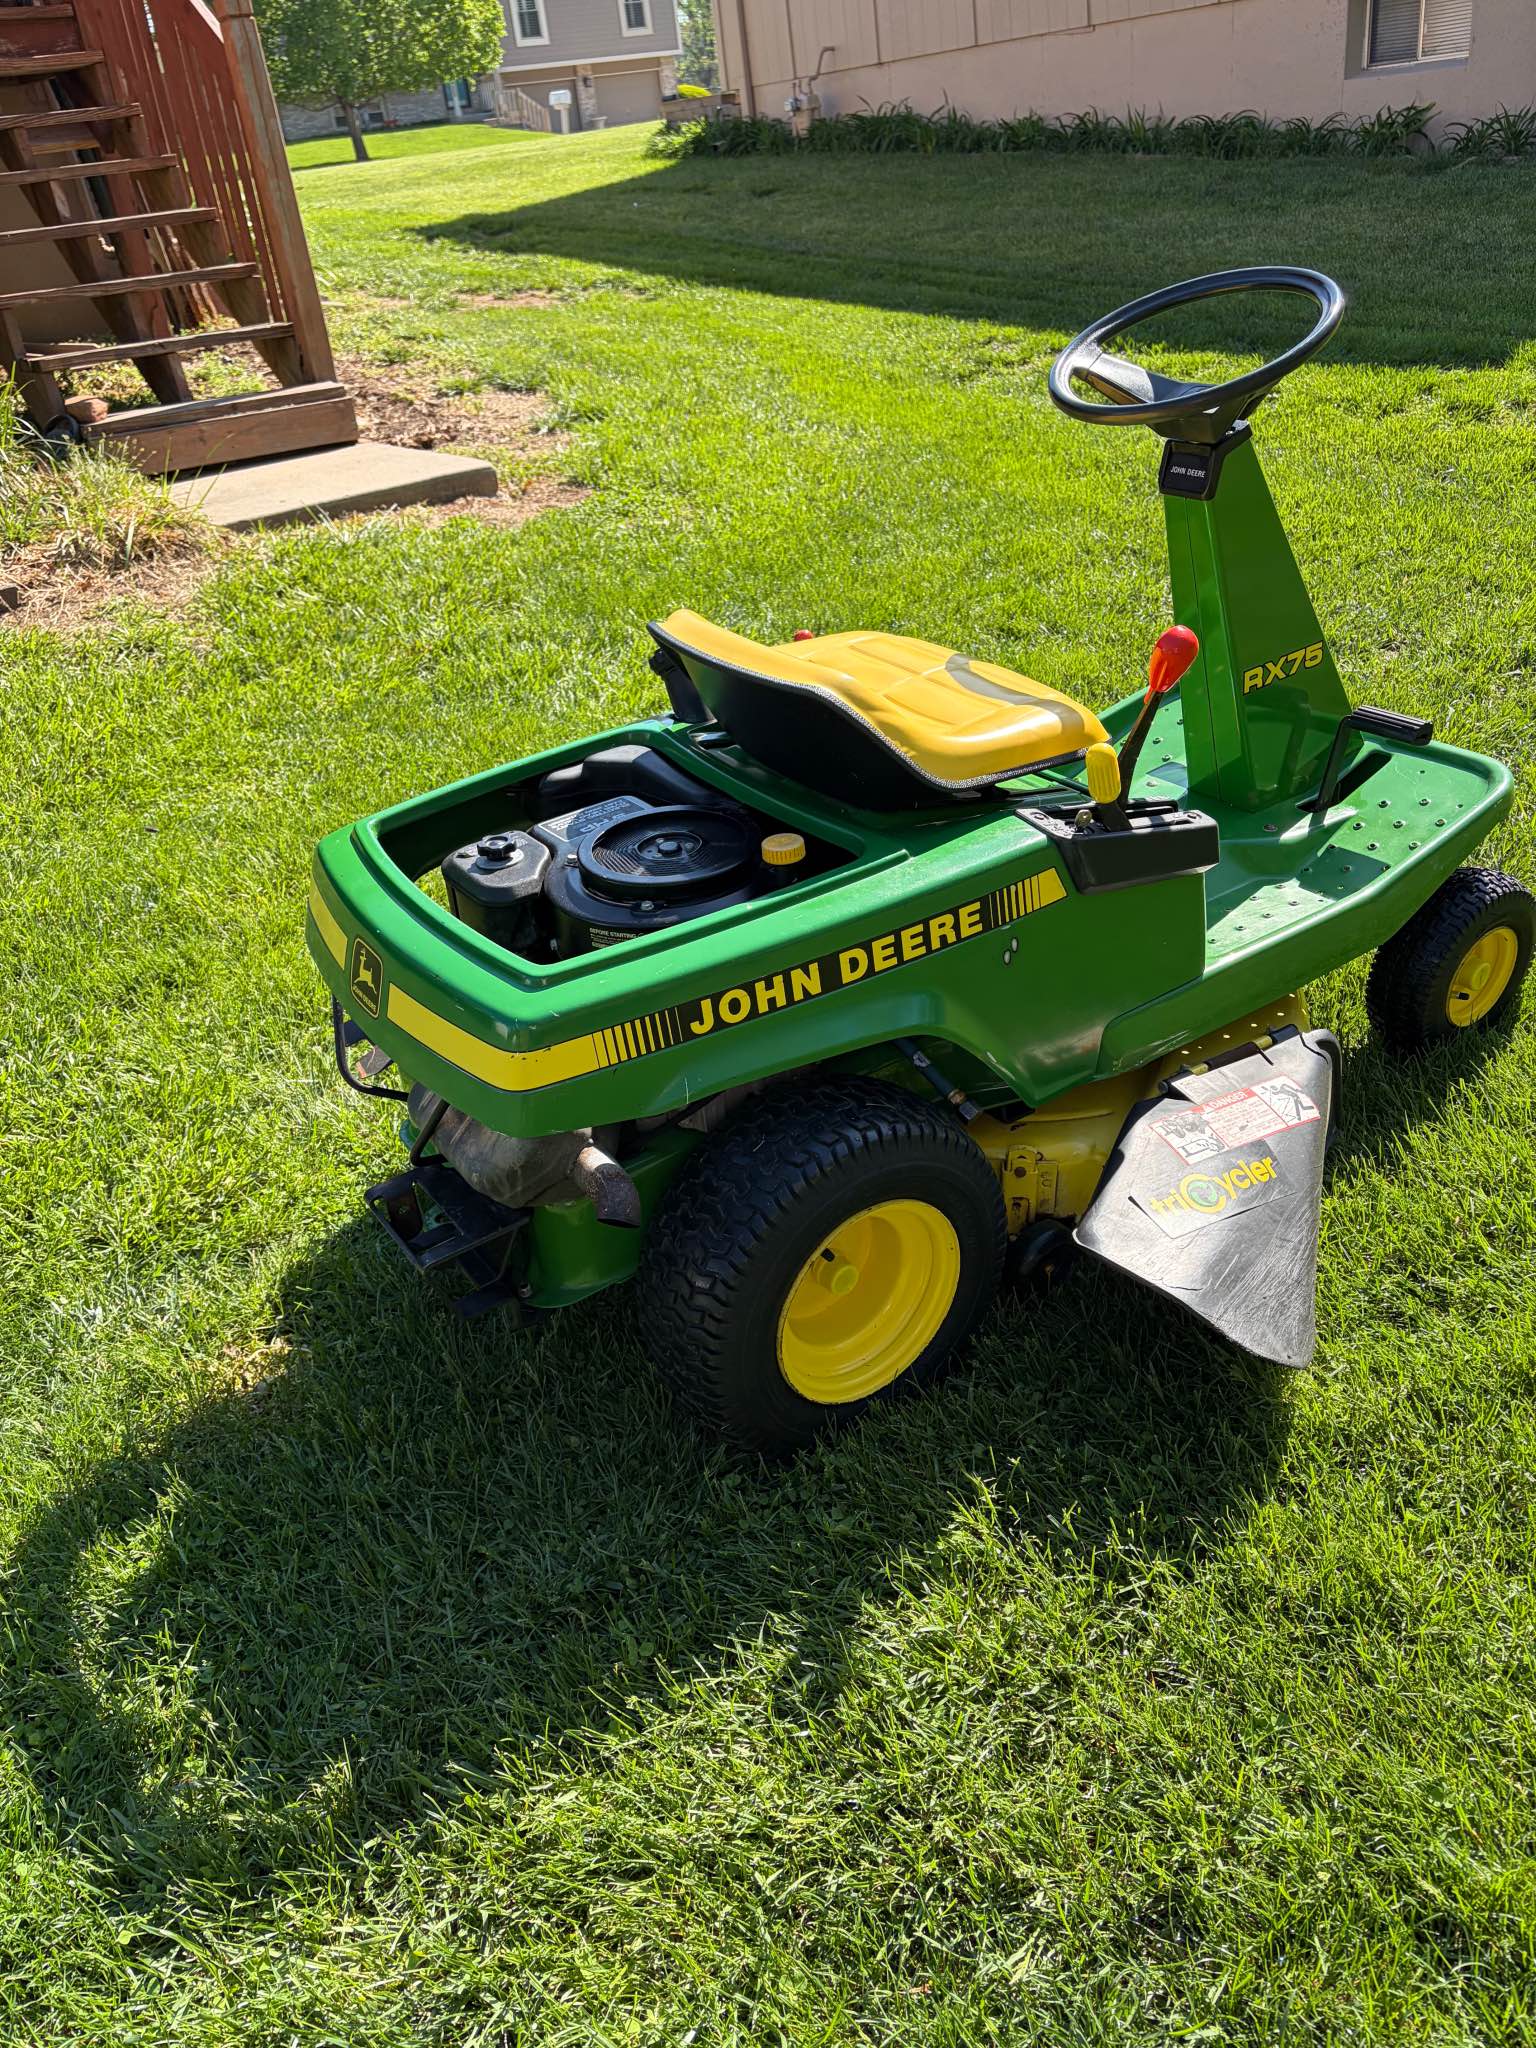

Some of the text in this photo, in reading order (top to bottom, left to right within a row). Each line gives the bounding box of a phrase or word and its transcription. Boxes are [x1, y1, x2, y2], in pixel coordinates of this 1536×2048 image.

[1170, 465, 1206, 478] JOHN DEERE
[1243, 640, 1323, 695] RX75
[690, 901, 983, 1035] JOHN DEERE
[1209, 1091, 1249, 1110] DANGER
